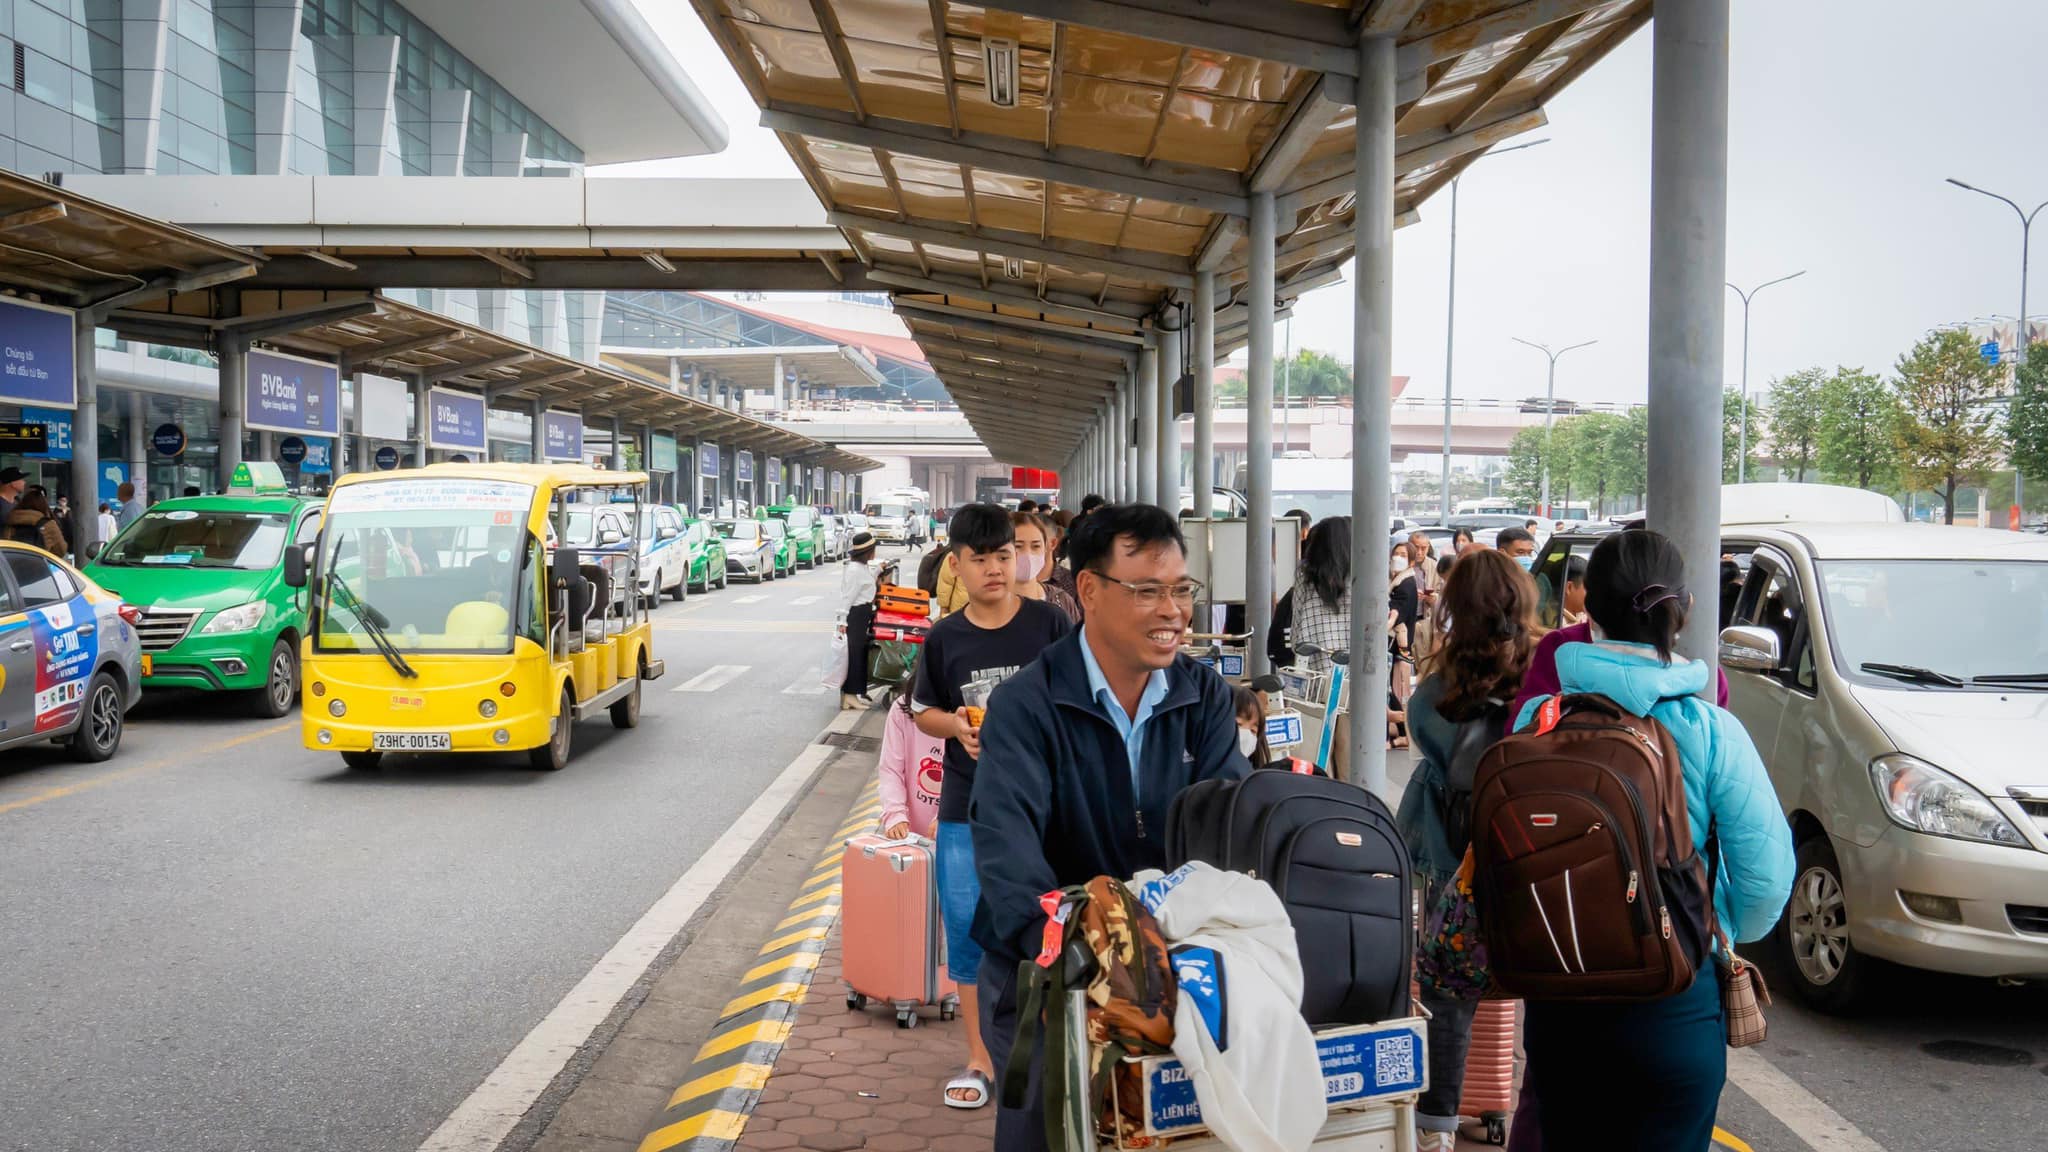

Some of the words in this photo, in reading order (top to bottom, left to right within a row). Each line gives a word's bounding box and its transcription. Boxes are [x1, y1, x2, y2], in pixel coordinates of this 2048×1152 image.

[261, 373, 297, 400] BVBank
[437, 405, 459, 425] BVBank
[64, 630, 80, 651] TAXI
[379, 735, 445, 748] 29HC-001.54
[916, 789, 941, 806] LOTS
[1162, 1103, 1184, 1120] LIÊN
